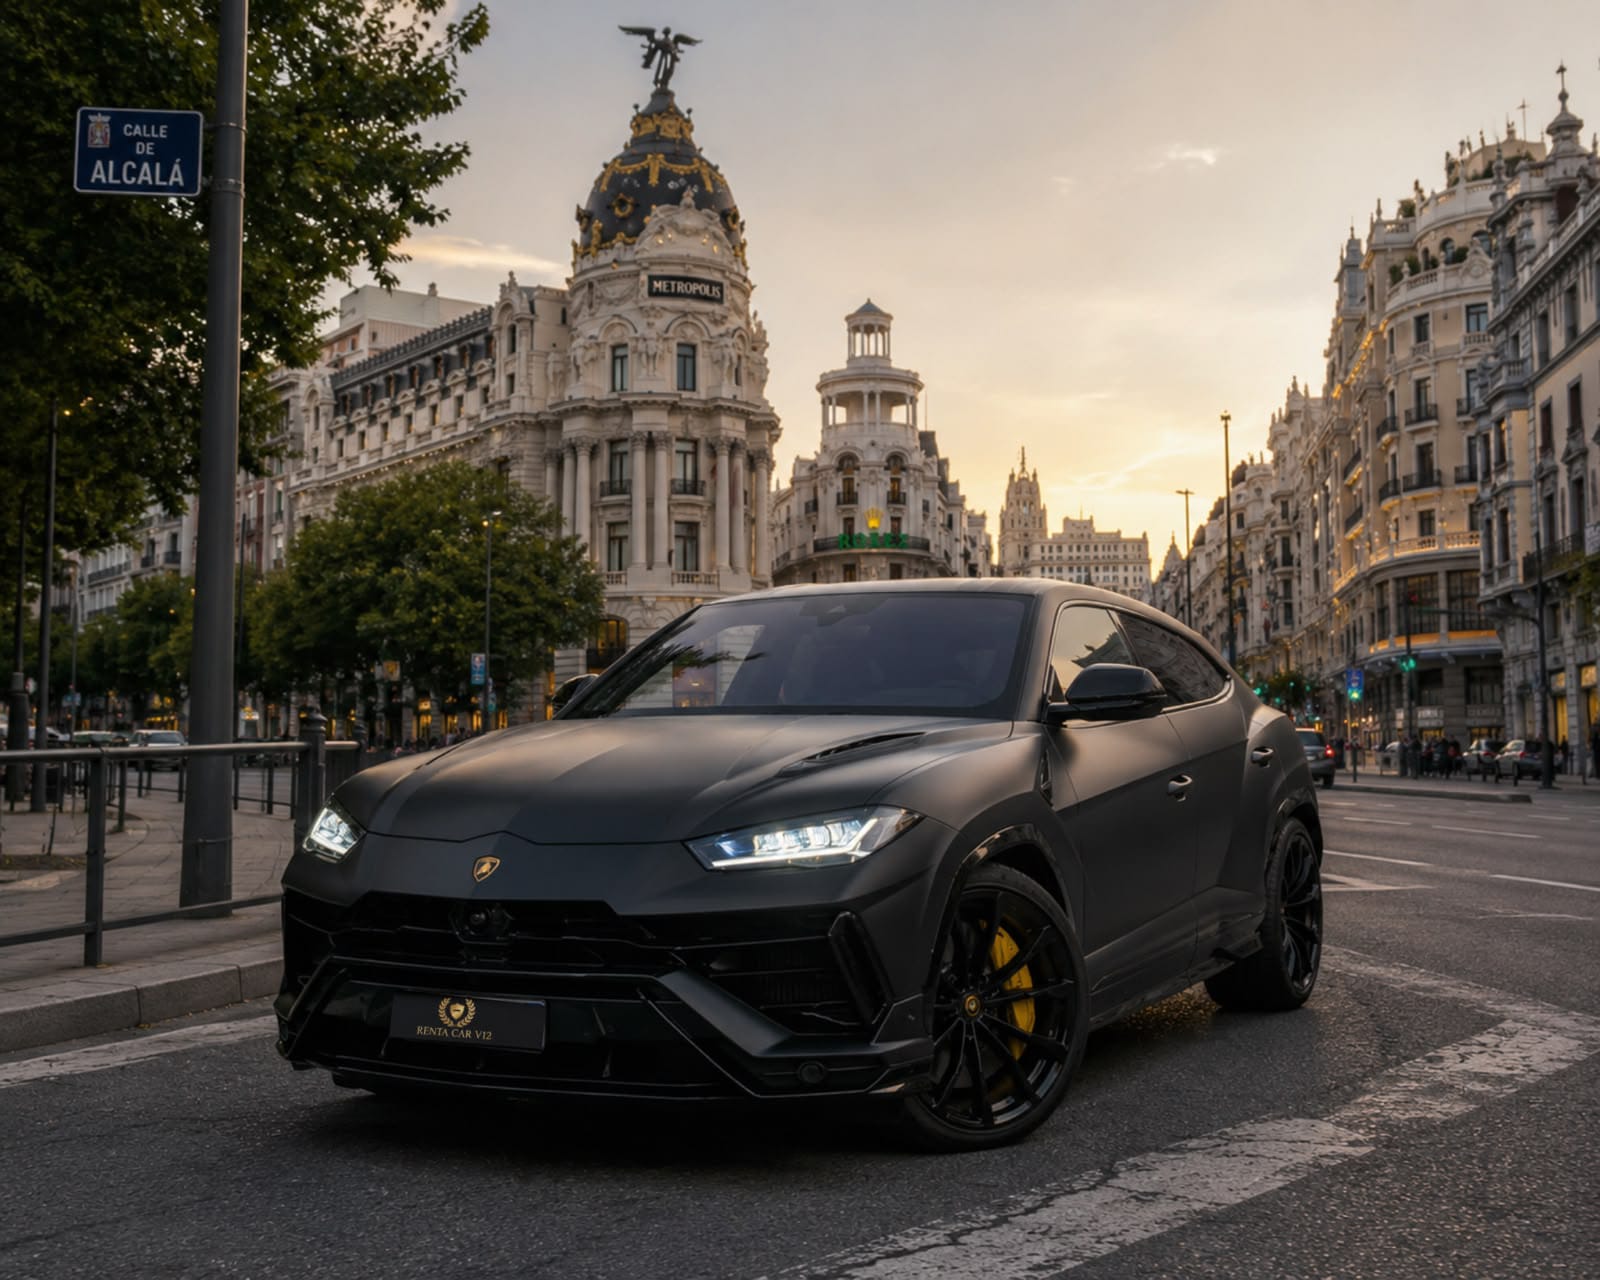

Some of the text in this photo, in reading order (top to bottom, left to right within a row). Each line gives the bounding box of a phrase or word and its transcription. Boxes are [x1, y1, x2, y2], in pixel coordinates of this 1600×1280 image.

[123, 123, 168, 138] CALLE
[135, 141, 155, 155] DE
[90, 158, 184, 186] ALCALÁ
[652, 280, 721, 298] METROPOLIS
[416, 1025, 493, 1041] RENTA CAR V12
